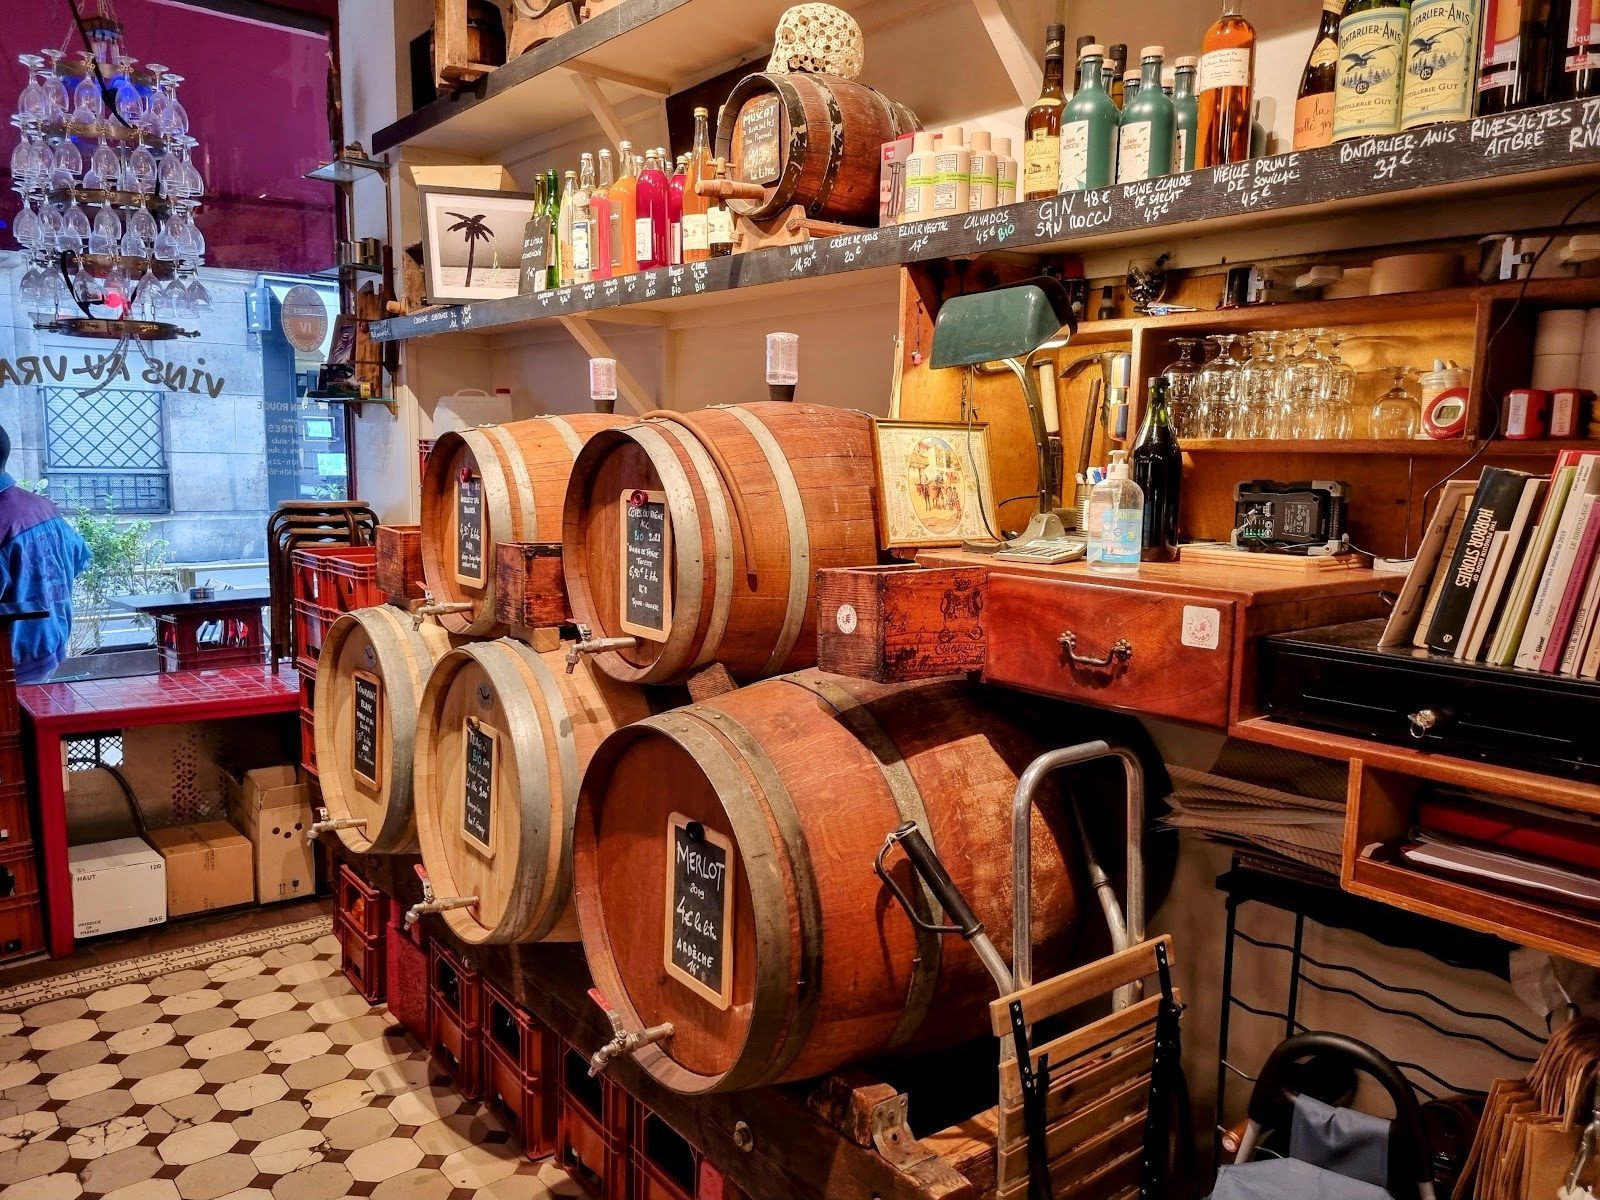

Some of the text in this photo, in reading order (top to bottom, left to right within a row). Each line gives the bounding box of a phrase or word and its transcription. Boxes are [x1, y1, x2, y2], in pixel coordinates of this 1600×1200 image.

[742, 105, 776, 127] MUSCAT
[1213, 153, 1300, 184] VIEILLE PRUNE
[1124, 175, 1192, 199] REINE CLAUDE
[1227, 180, 1245, 193] DE
[1039, 193, 1076, 221] GIN
[1135, 197, 1147, 209] DE
[963, 210, 1010, 230] CALVADOS
[898, 225, 923, 238] ELIXIR
[997, 225, 1015, 243] BIO
[1035, 221, 1063, 238] SAN
[646, 288, 656, 297] BIO
[1489, 520, 1498, 532] THE
[1455, 507, 1495, 588] HORROR STORIES
[1481, 531, 1494, 557] PENGUIN
[1568, 541, 1577, 550] LE
[1475, 557, 1486, 574] BOOK
[677, 840, 726, 891] MERLOT
[77, 874, 96, 882] HAUT
[689, 882, 705, 900] 2019
[148, 915, 163, 923] BAS
[676, 896, 693, 927] 4€
[693, 912, 703, 933] le
[676, 937, 714, 969] ARDÈCHE
